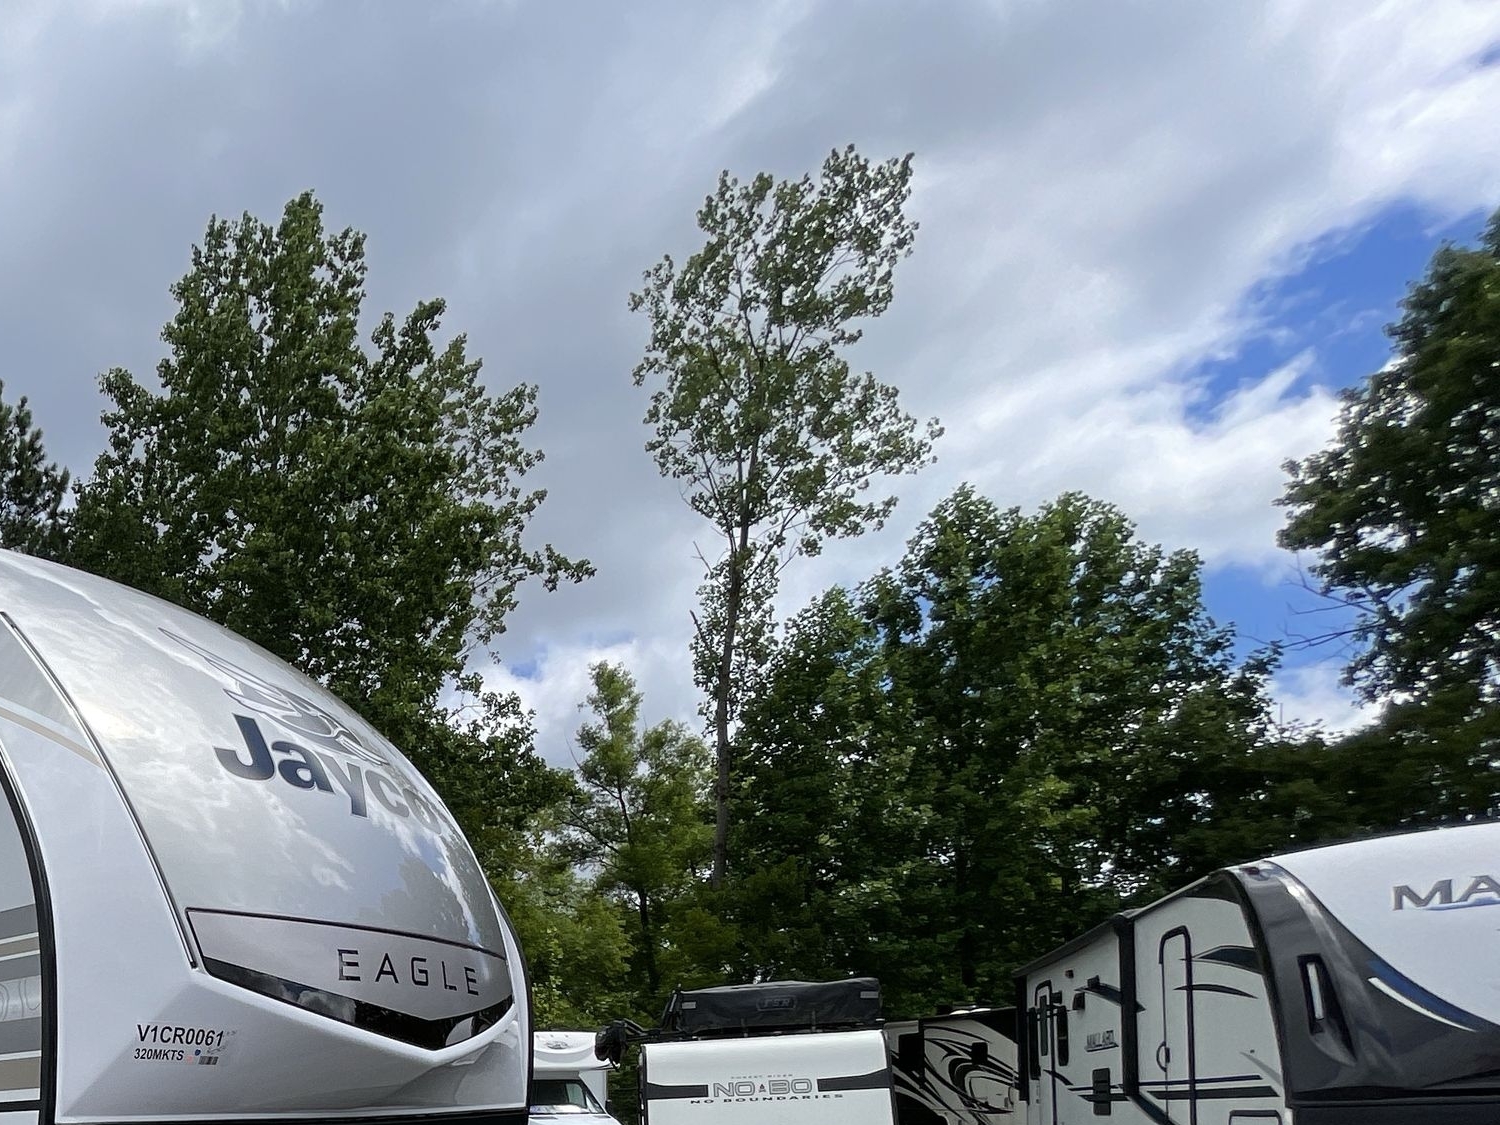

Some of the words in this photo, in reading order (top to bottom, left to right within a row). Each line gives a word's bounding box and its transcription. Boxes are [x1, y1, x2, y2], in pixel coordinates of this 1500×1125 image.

[213, 713, 442, 835] Jayco
[337, 949, 480, 996] EAGLE
[136, 1024, 225, 1047] V1CR0061
[133, 1048, 185, 1061] 320MKTS
[723, 1094, 844, 1103] BOUNDARIES
